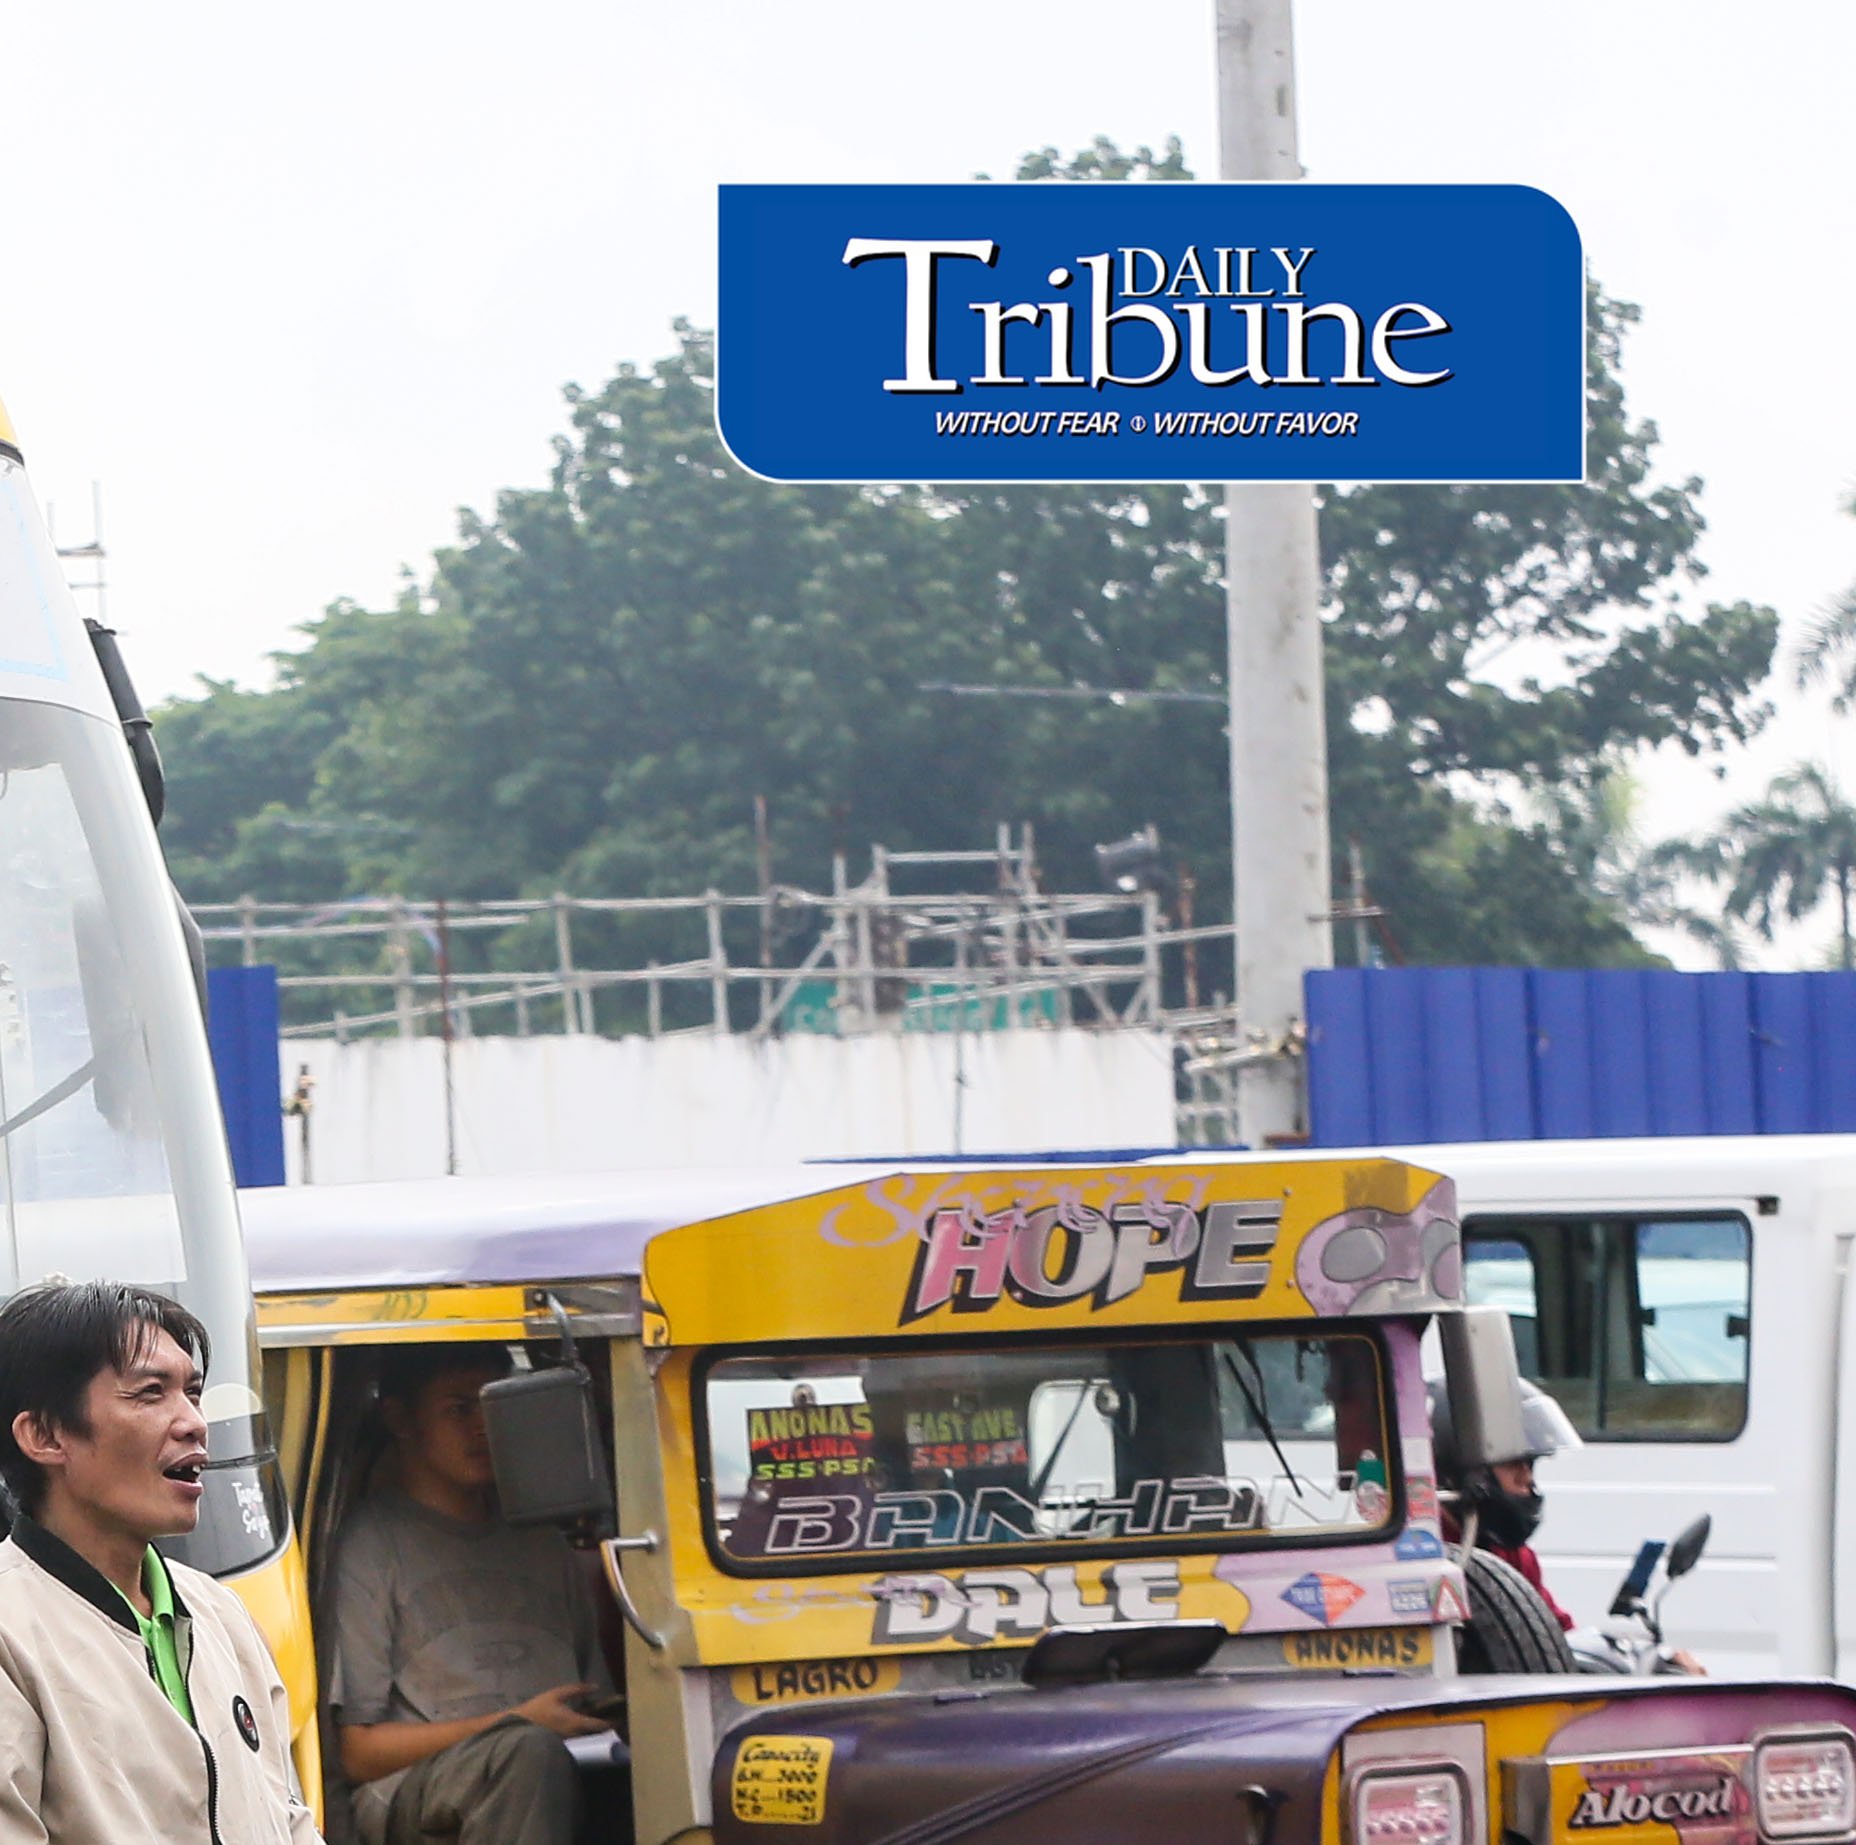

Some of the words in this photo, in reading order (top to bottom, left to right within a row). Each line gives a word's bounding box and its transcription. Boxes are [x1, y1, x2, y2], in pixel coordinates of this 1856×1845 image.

[901, 1201, 1284, 1324] HOPE
[750, 1404, 875, 1442] ANONAS
[906, 1412, 965, 1443] EAST
[876, 1561, 1182, 1643] DALE
[1295, 1631, 1420, 1664] ANONAS
[752, 1658, 878, 1700] LAGRO
